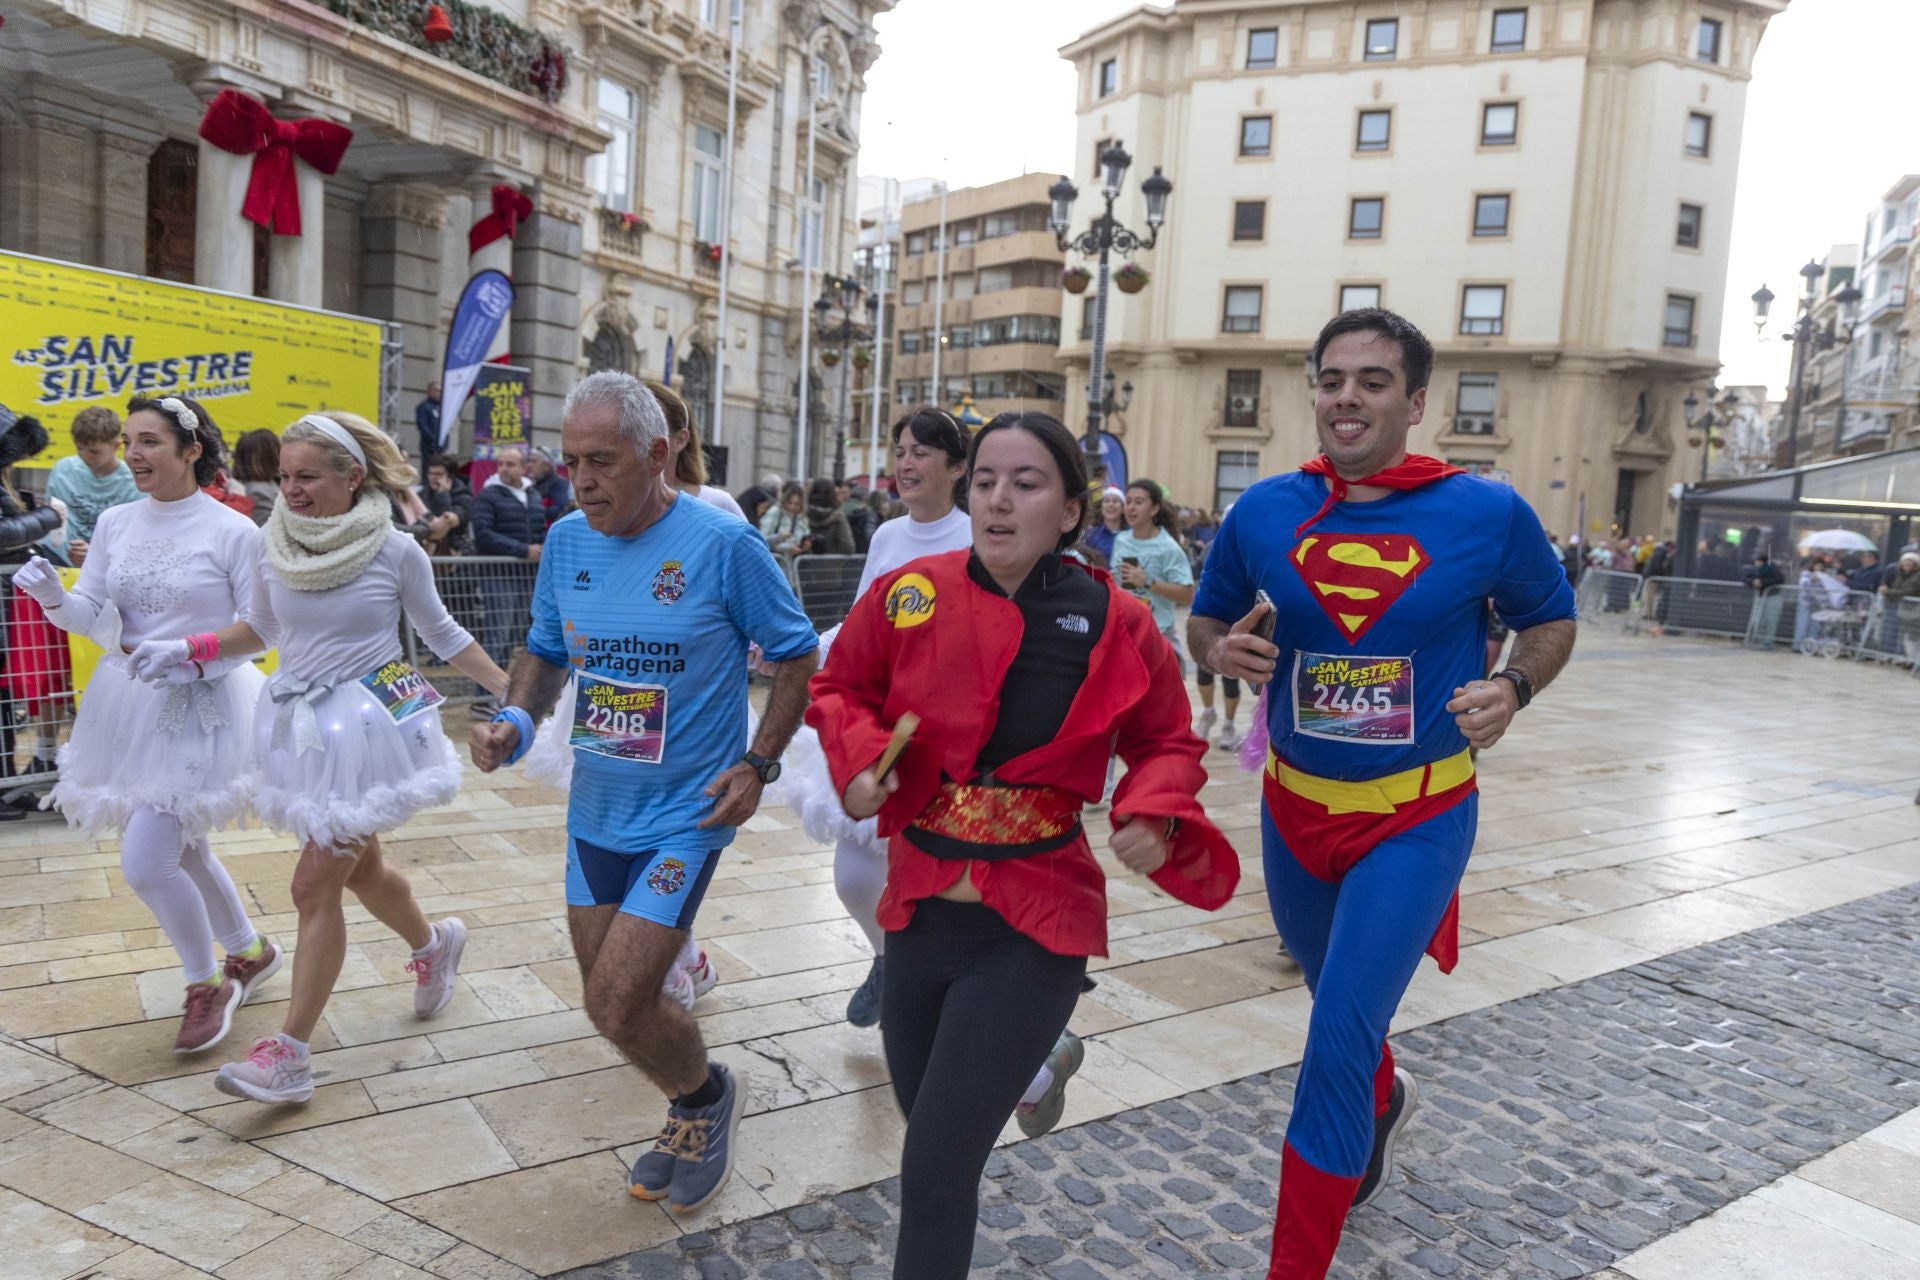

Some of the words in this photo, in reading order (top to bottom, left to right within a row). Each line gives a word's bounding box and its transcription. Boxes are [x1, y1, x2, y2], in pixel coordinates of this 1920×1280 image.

[43, 334, 134, 367] SAN
[40, 351, 252, 403] SILVESTRE
[488, 381, 524, 398] SAN
[490, 424, 523, 438] TRE
[1317, 661, 1401, 685] SILVESTRE
[1319, 660, 1349, 674] SAN
[1351, 674, 1401, 688] CARTAGENA
[592, 691, 656, 706] SILVESTRE
[593, 685, 615, 696] SAN
[614, 701, 656, 711] CARTAGENA
[1313, 683, 1391, 715] 2465
[585, 703, 646, 737] 2208
